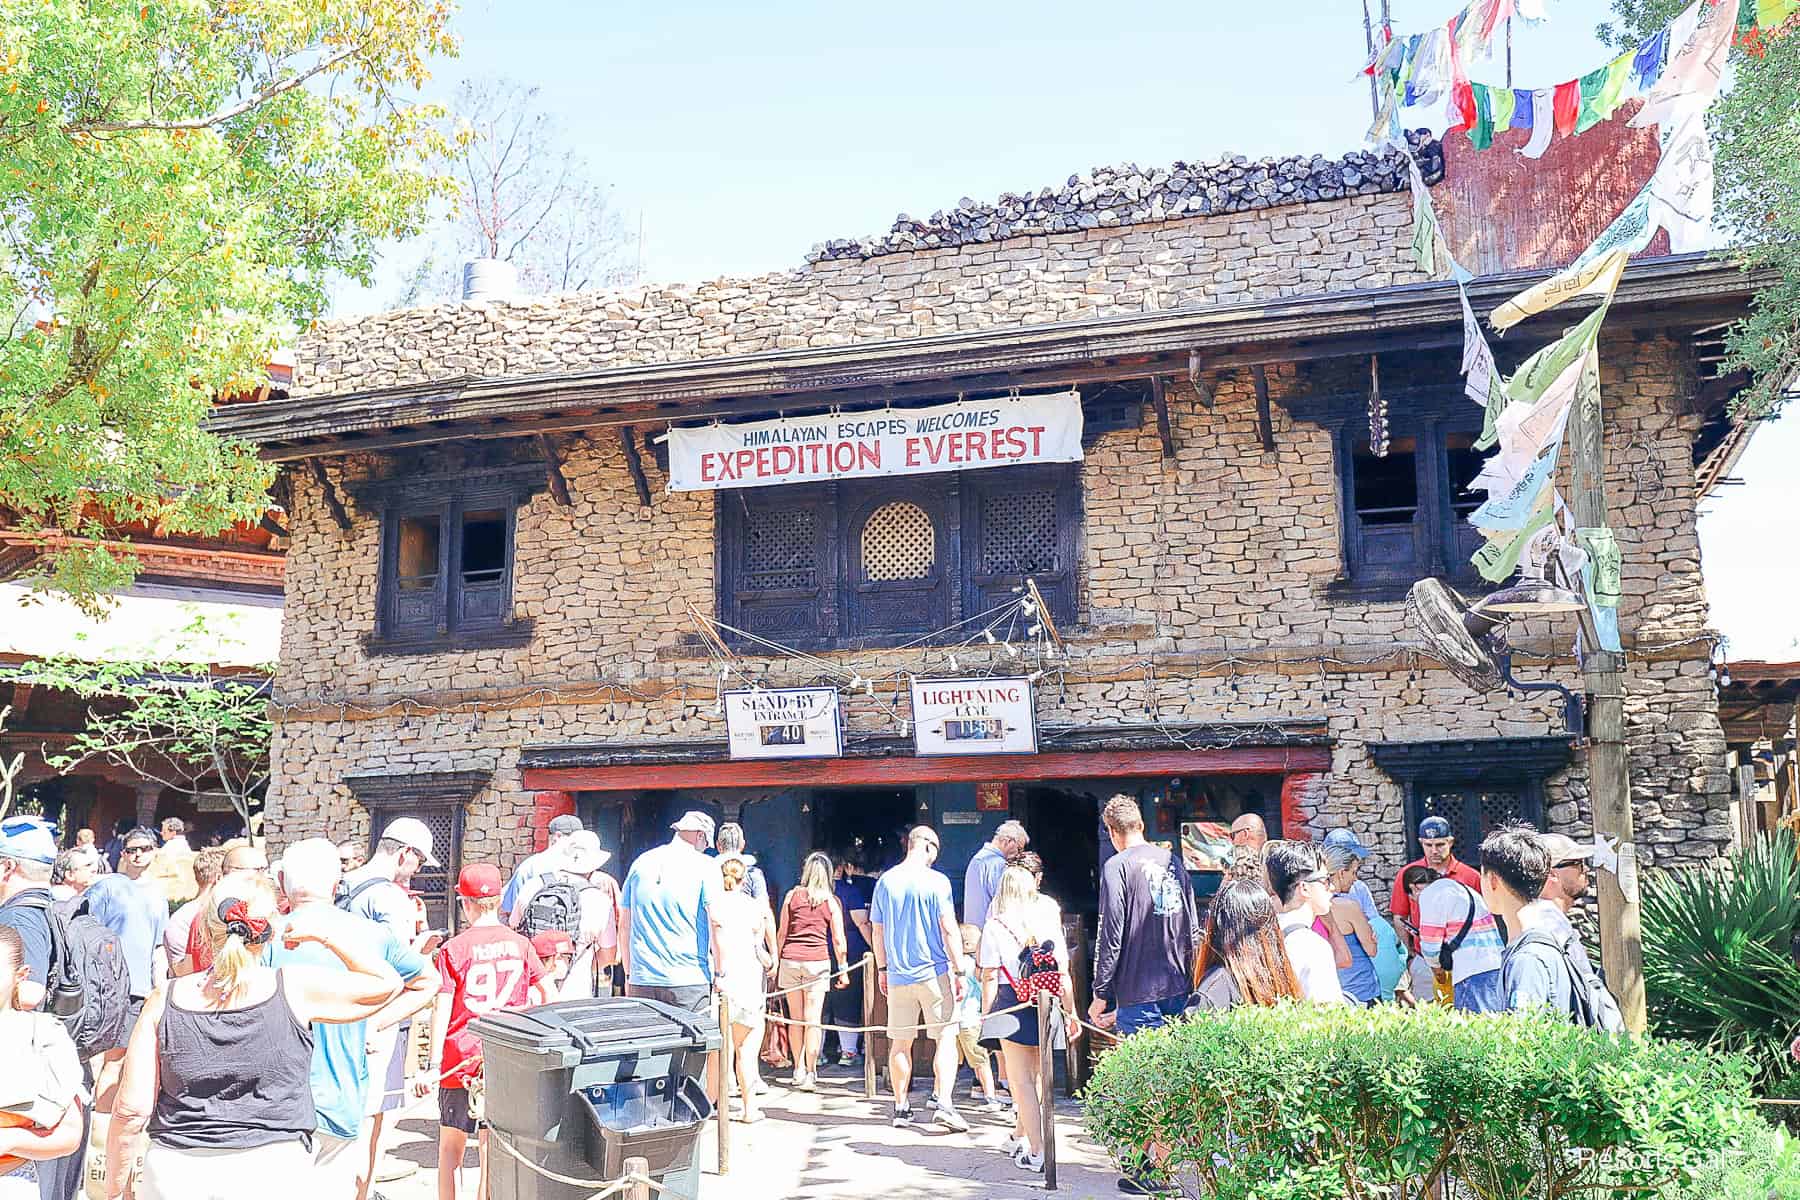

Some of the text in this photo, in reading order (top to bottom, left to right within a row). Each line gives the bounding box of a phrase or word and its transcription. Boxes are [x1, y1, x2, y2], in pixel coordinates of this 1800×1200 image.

[743, 409, 1001, 447] HIMALAYAN ESCAPES WELCOMES
[701, 426, 1046, 482] EXPEDITION EVEREST
[922, 687, 1020, 705] LIGHTNING
[754, 709, 808, 721] ENTRANCE
[955, 705, 989, 717] LANE
[782, 725, 801, 741] 40
[463, 959, 524, 1014] 97
